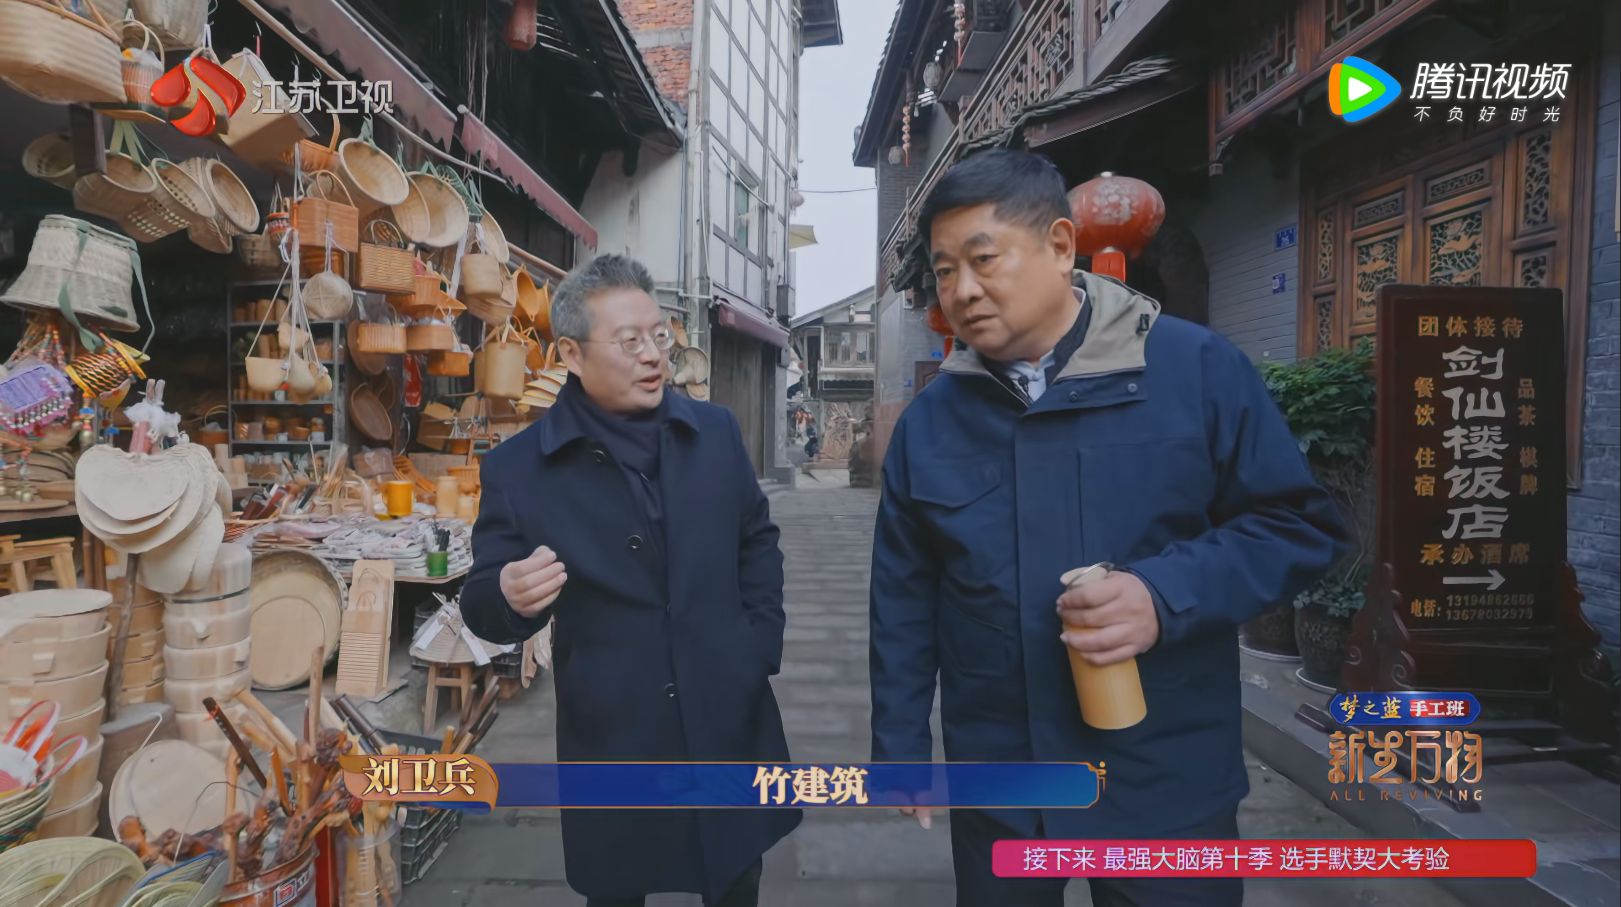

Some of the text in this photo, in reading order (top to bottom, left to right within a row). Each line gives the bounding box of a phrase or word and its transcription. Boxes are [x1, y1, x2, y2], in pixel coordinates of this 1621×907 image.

[1418, 316, 1523, 339] 团体接待
[1414, 377, 1436, 496] 餐饮 住宿
[1442, 345, 1510, 539] 剑仙楼饭店
[1518, 378, 1538, 496] 品茶 棋牌
[1420, 544, 1530, 565] 承办酒席
